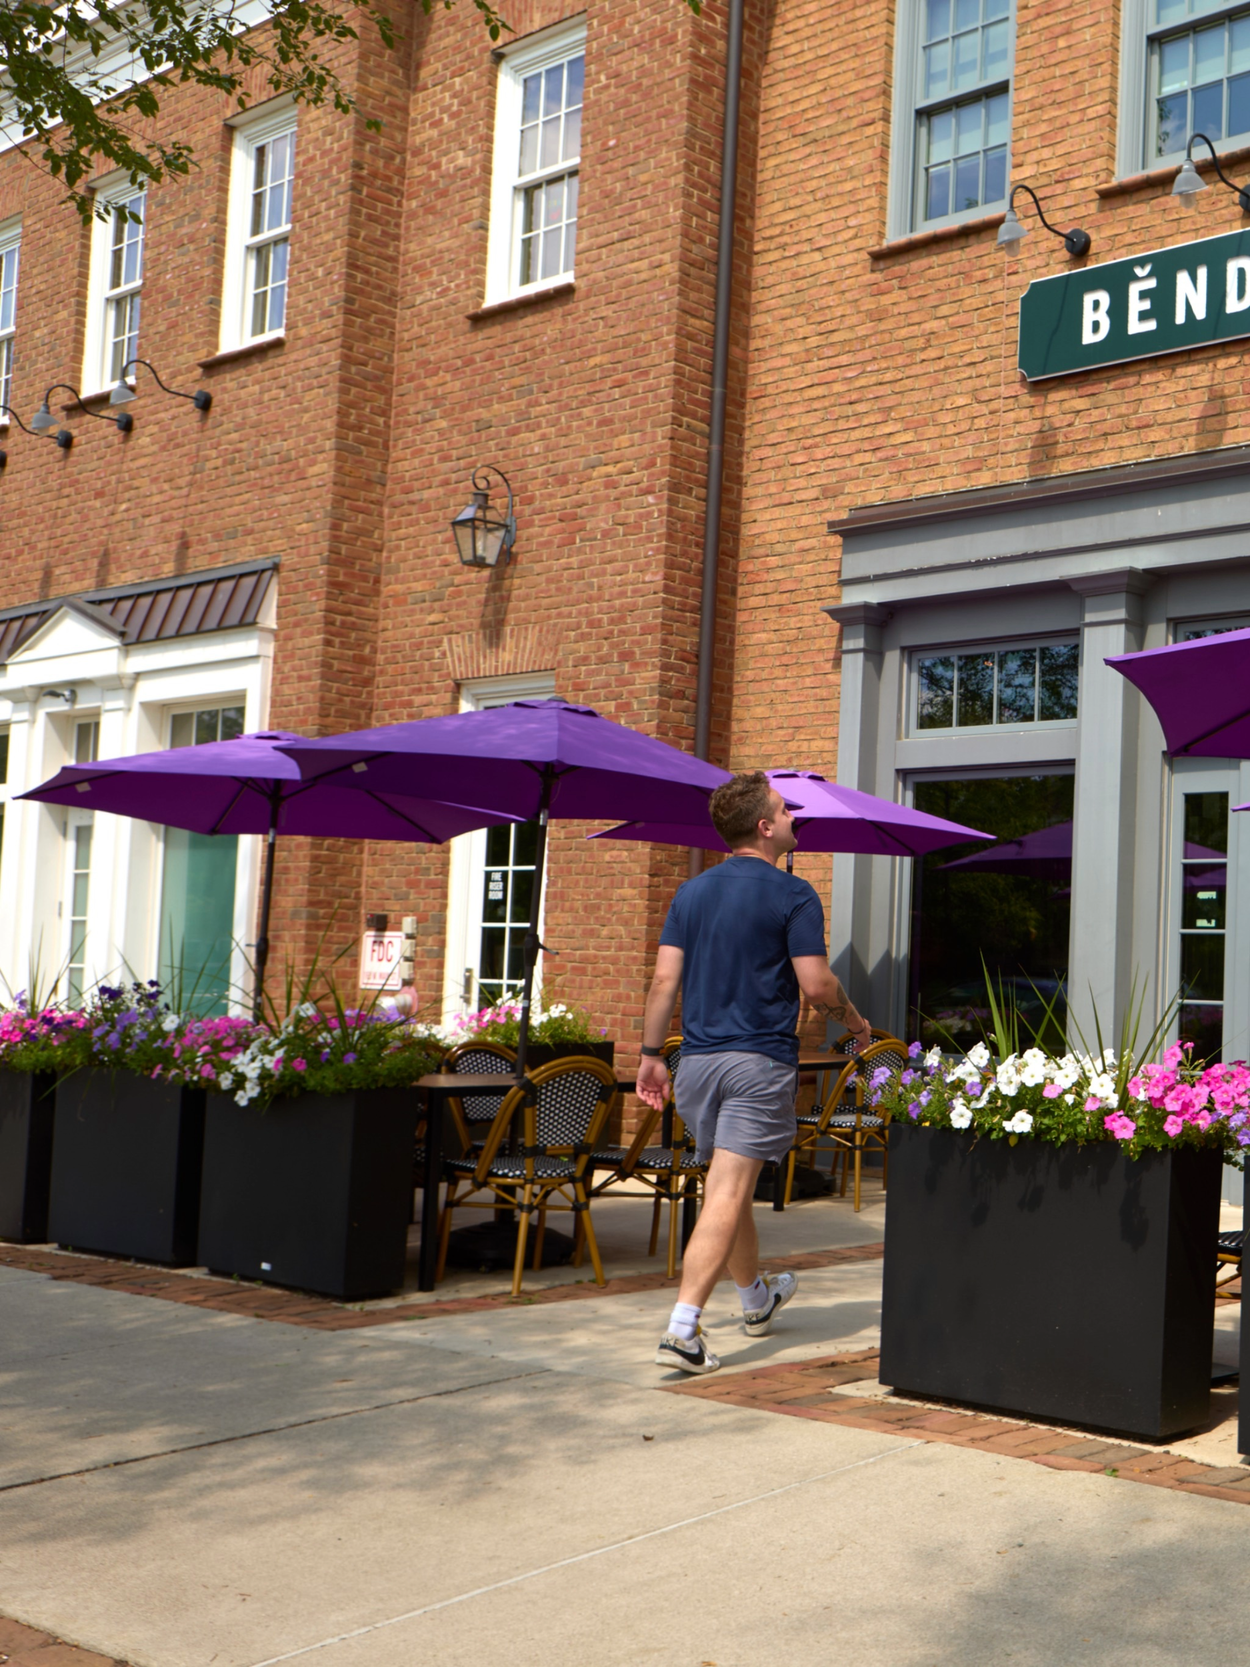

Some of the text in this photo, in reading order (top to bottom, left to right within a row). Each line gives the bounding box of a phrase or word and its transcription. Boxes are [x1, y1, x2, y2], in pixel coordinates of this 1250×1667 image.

[491, 871, 502, 881] FIRE
[489, 881, 503, 890] RISER
[370, 940, 394, 962] FDC
